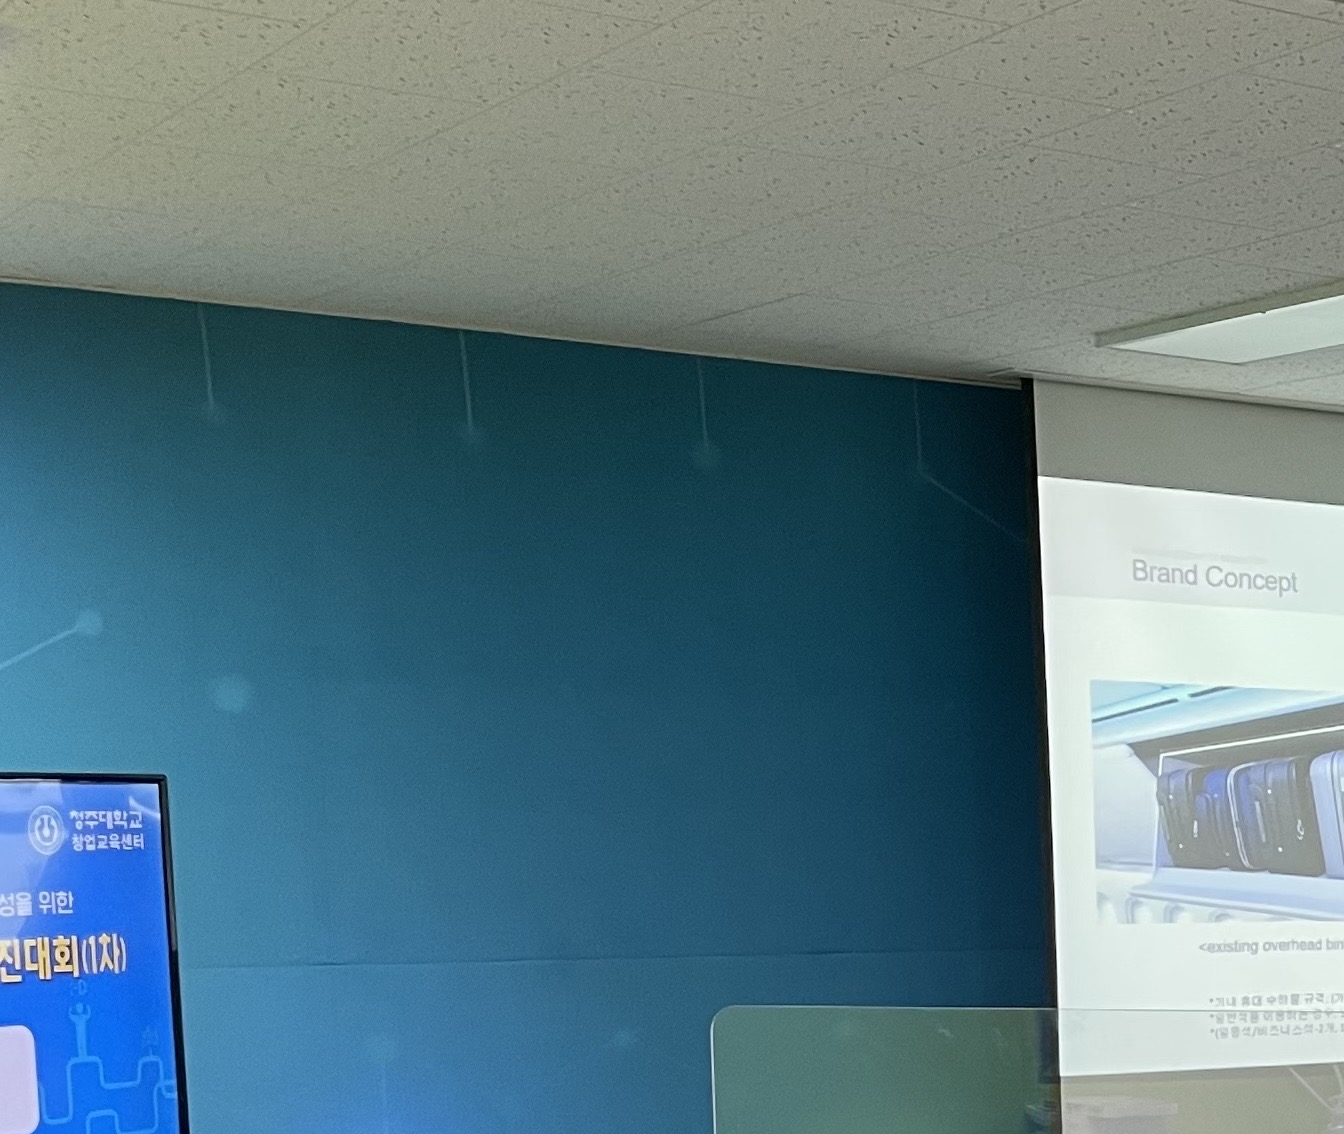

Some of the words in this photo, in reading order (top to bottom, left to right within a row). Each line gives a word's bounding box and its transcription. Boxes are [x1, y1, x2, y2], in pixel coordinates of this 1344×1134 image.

[1132, 558, 1199, 586] Brand
[1205, 565, 1299, 598] Concept
[69, 809, 144, 830] 청주대학교
[72, 833, 145, 852] 창업교육센터
[39, 890, 75, 915] 위한
